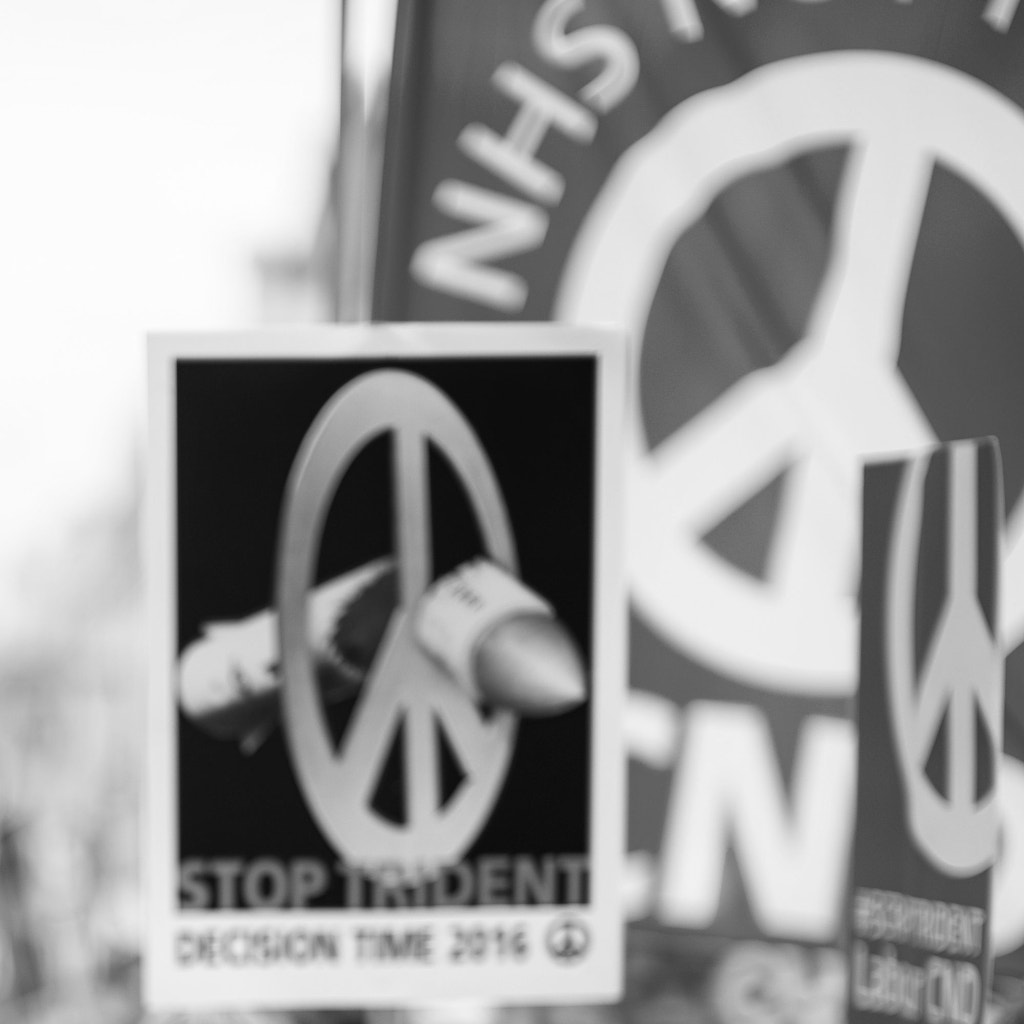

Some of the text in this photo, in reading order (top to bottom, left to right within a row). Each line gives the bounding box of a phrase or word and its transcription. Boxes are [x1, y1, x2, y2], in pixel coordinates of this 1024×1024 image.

[409, 0, 641, 313] NHS
[178, 854, 590, 908] STOP TRIDENT
[176, 923, 531, 966] DECISION TIME 2016
